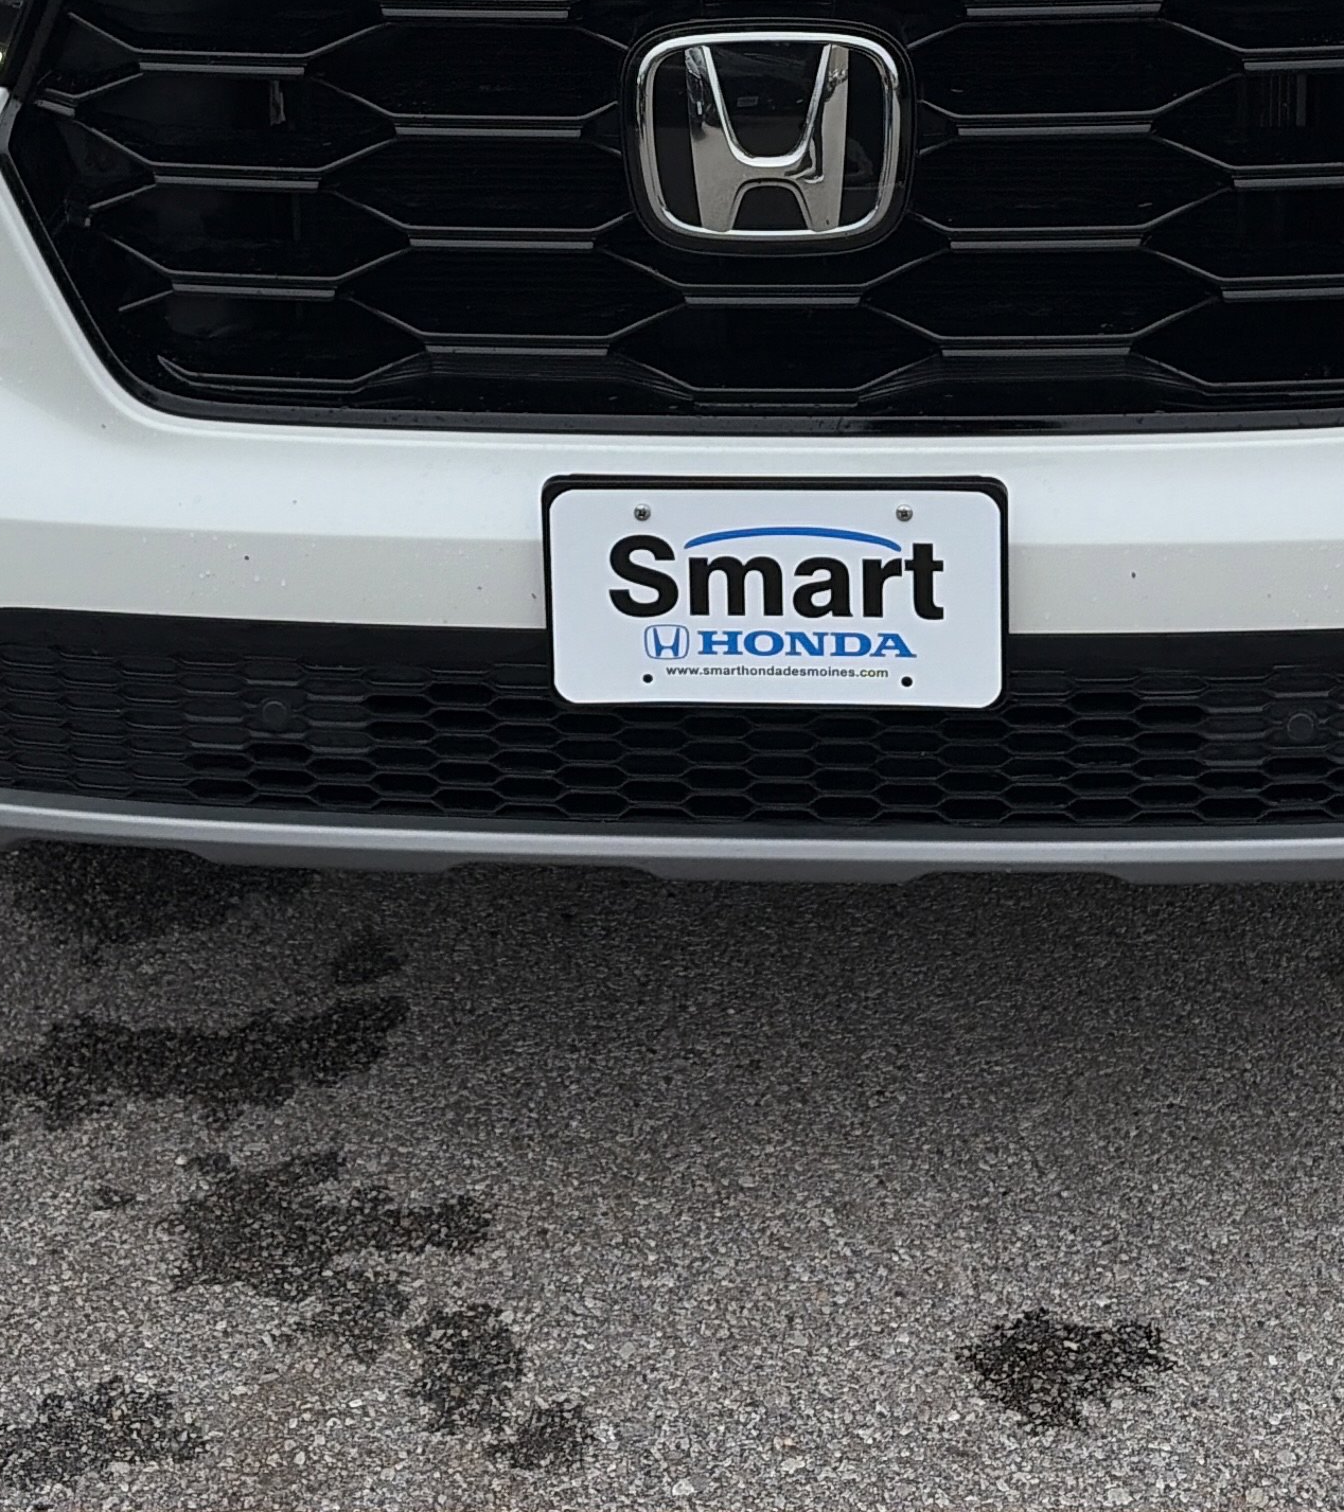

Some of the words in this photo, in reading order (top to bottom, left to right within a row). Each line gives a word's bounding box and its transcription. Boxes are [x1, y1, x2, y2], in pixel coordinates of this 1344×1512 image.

[608, 534, 944, 620] Smart
[697, 630, 917, 658] HONDA
[666, 665, 889, 678] www.smarthondadesmoines.com
